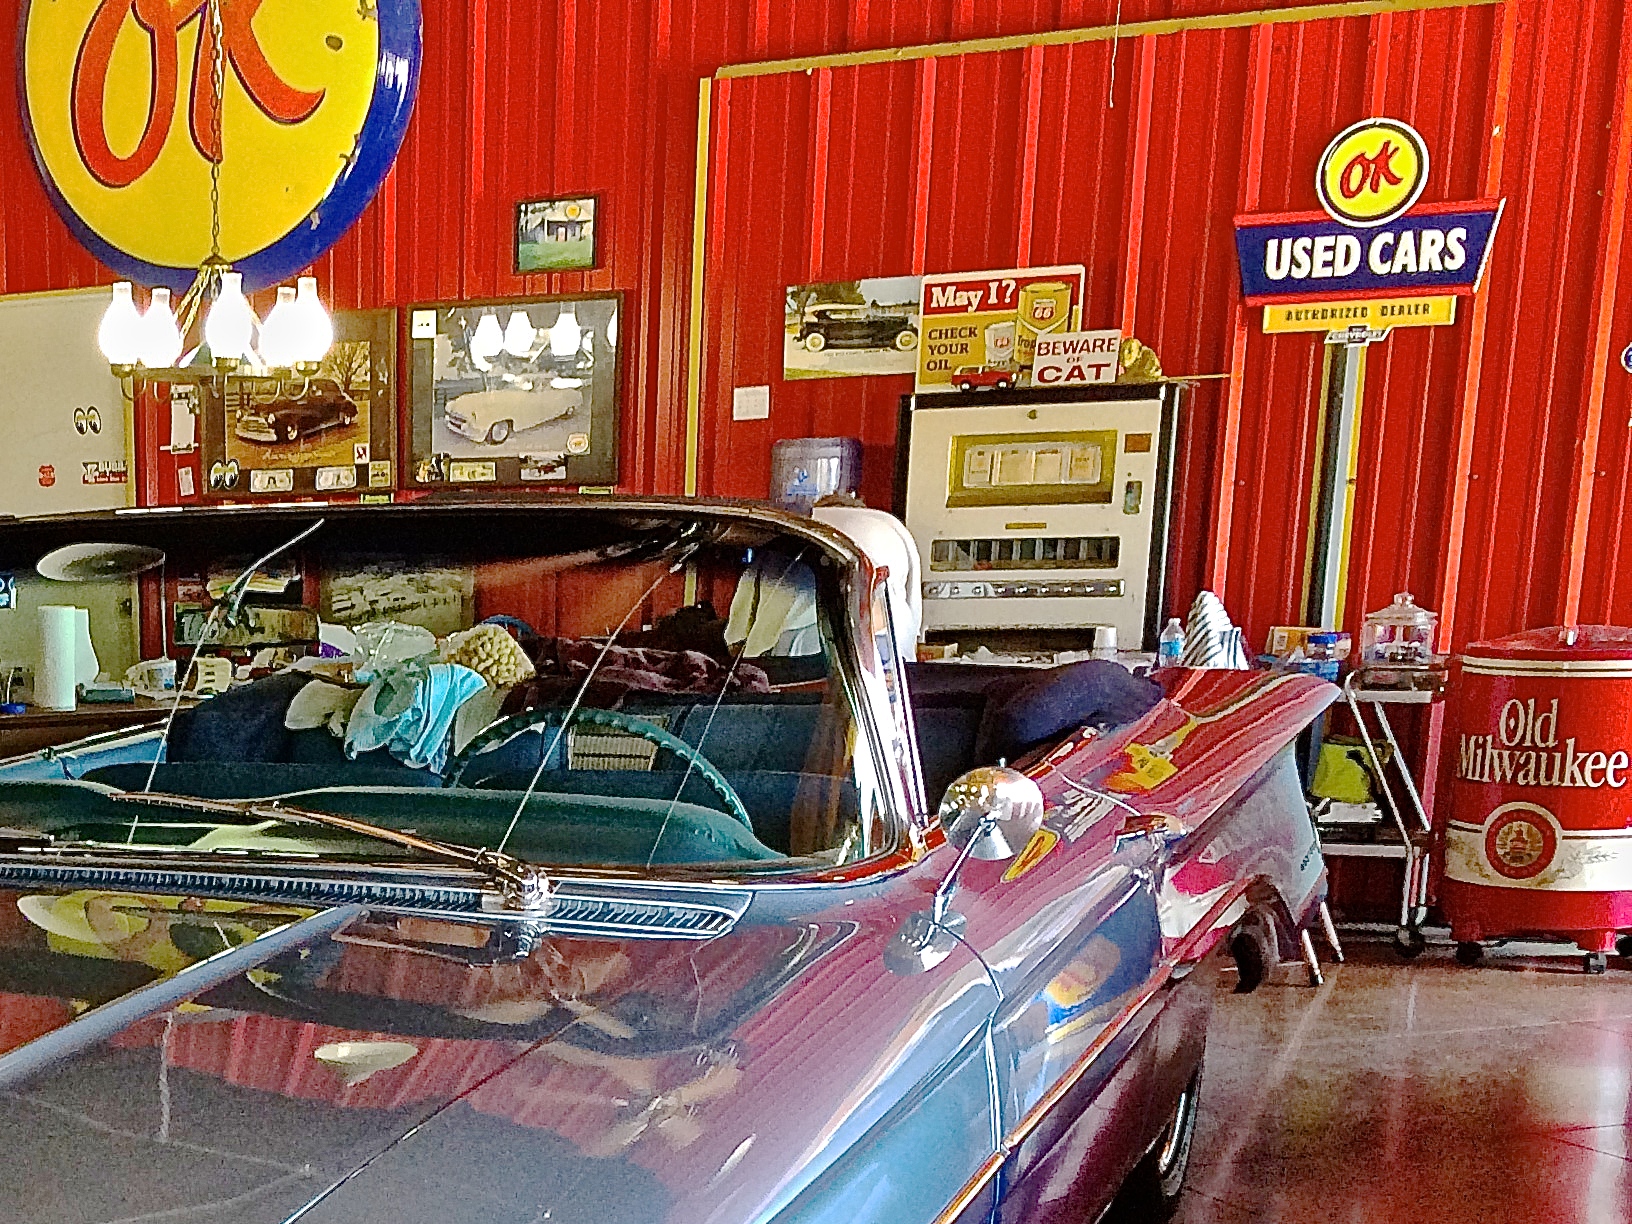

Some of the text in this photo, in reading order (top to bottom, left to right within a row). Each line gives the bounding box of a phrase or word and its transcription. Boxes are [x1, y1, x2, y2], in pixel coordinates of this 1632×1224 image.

[1340, 139, 1402, 199] OK
[1265, 226, 1467, 281] USED CARS
[930, 280, 1016, 312] May I?
[1034, 308, 1053, 319] 66
[1285, 303, 1430, 321] AUTHORIZED DEALER
[927, 325, 978, 340] CHECK
[927, 344, 969, 357] YOUR
[1036, 337, 1118, 357] BEWARE
[926, 359, 952, 373] OIL
[1066, 356, 1083, 364] OF
[1037, 362, 1112, 384] CAT
[1499, 697, 1559, 748] Old
[1456, 733, 1629, 788] Milwaukee
